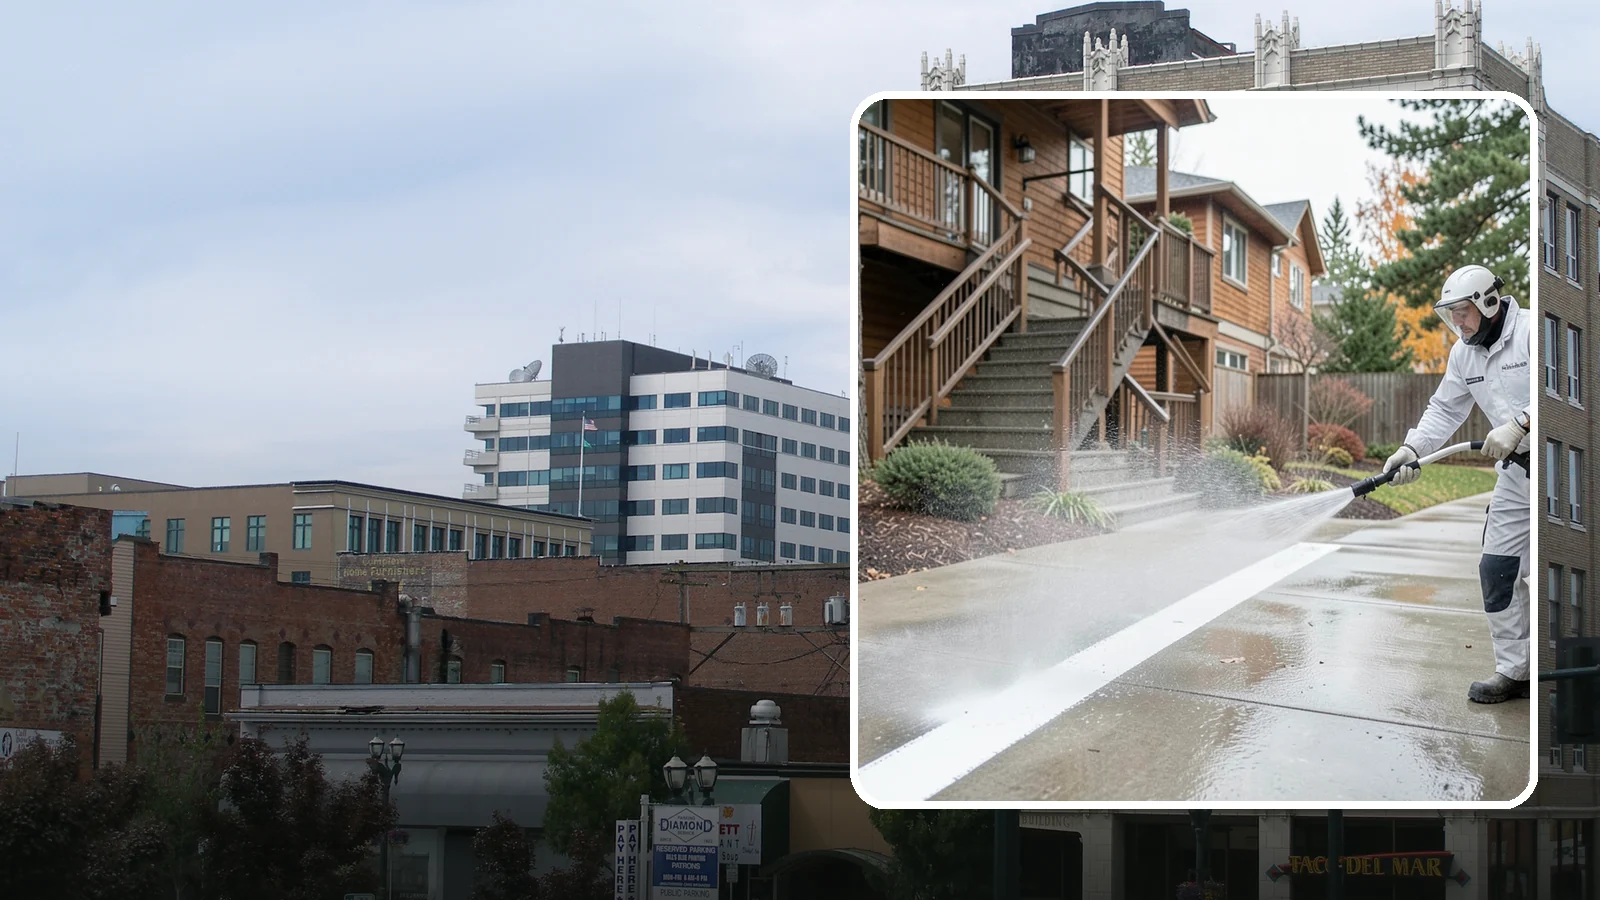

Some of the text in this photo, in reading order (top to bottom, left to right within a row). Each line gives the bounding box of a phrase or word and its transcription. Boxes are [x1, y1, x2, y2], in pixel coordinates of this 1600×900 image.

[660, 818, 713, 833] DIAMOND
[1022, 815, 1070, 827] BUILDING
[656, 845, 716, 854] RESERVED PARKING
[616, 825, 625, 893] PAY HERE
[627, 824, 636, 893] PAY HERE
[721, 851, 739, 863] Soup
[671, 862, 701, 870] PATRONS
[1346, 856, 1385, 876] DEL
[1392, 857, 1442, 877] MAR
[660, 888, 710, 898] PUBLIC PARKING
